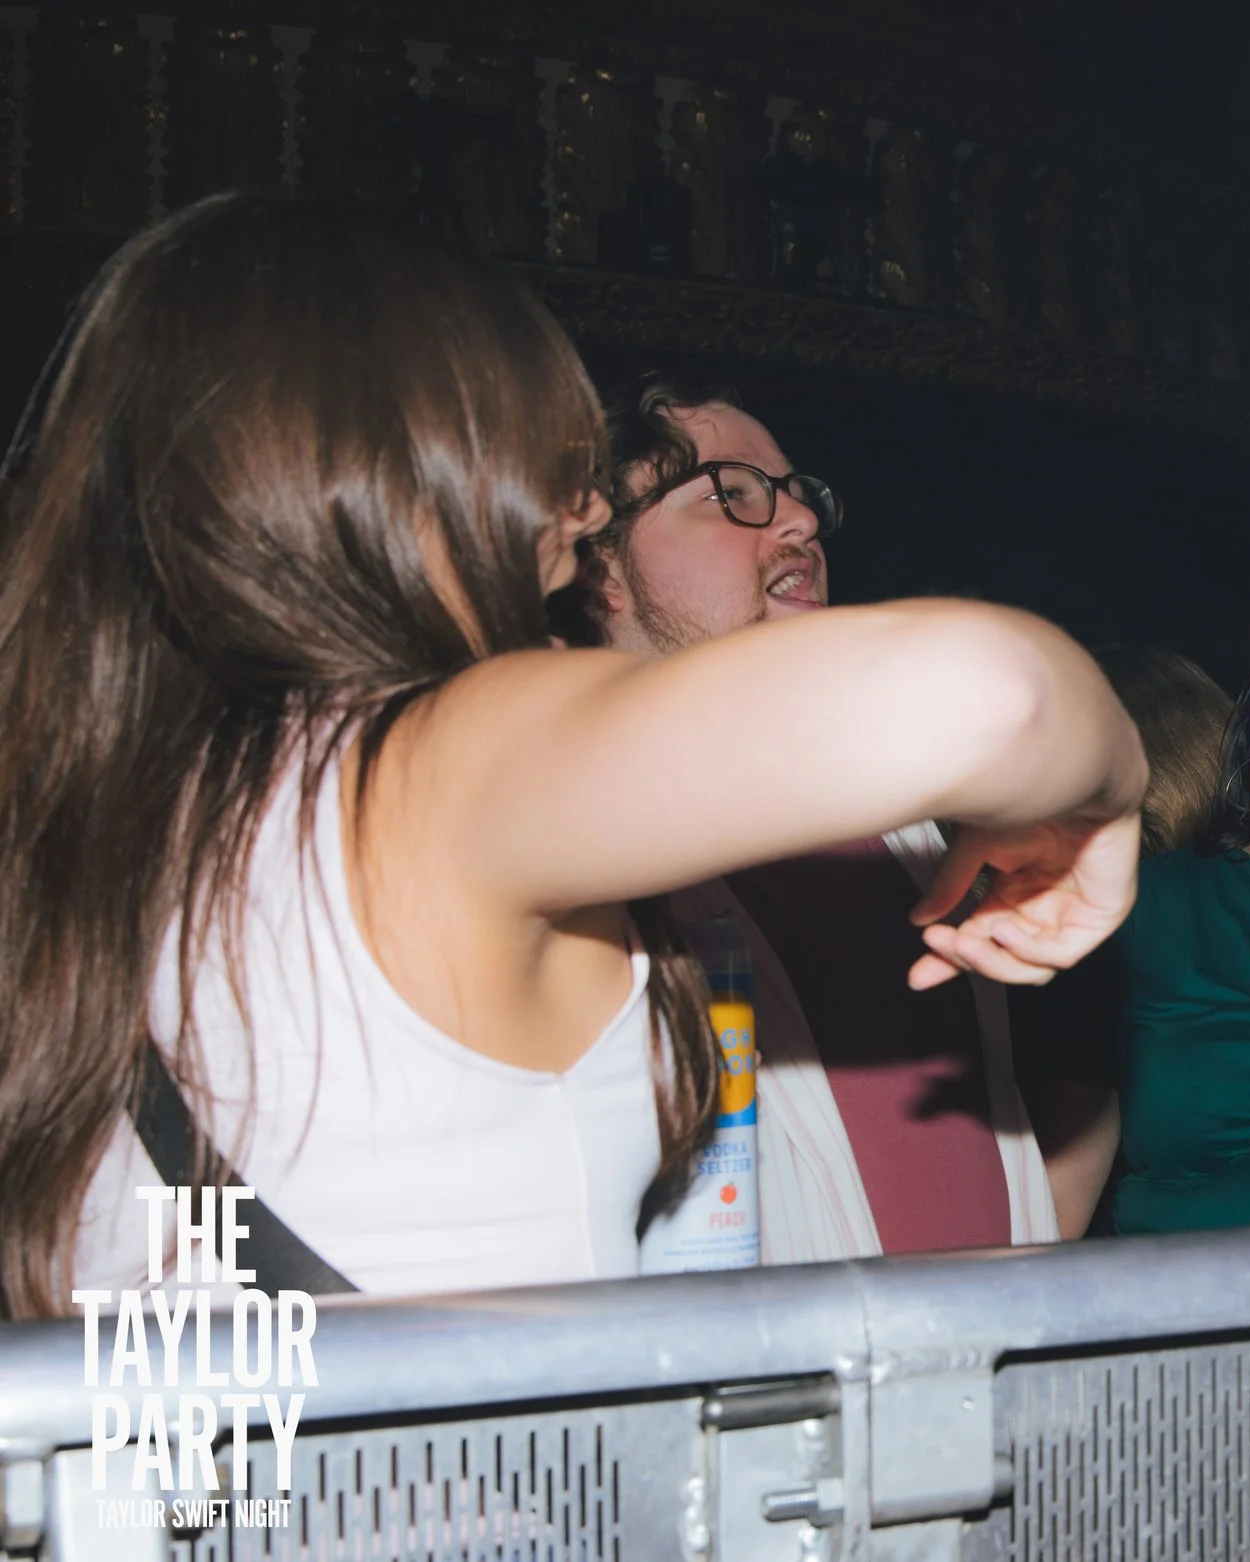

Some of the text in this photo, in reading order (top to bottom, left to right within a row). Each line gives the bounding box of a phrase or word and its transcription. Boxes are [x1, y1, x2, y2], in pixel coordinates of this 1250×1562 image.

[703, 1141, 748, 1158] VODKA
[697, 1158, 753, 1175] SELTZER
[708, 1210, 746, 1230] PEACH
